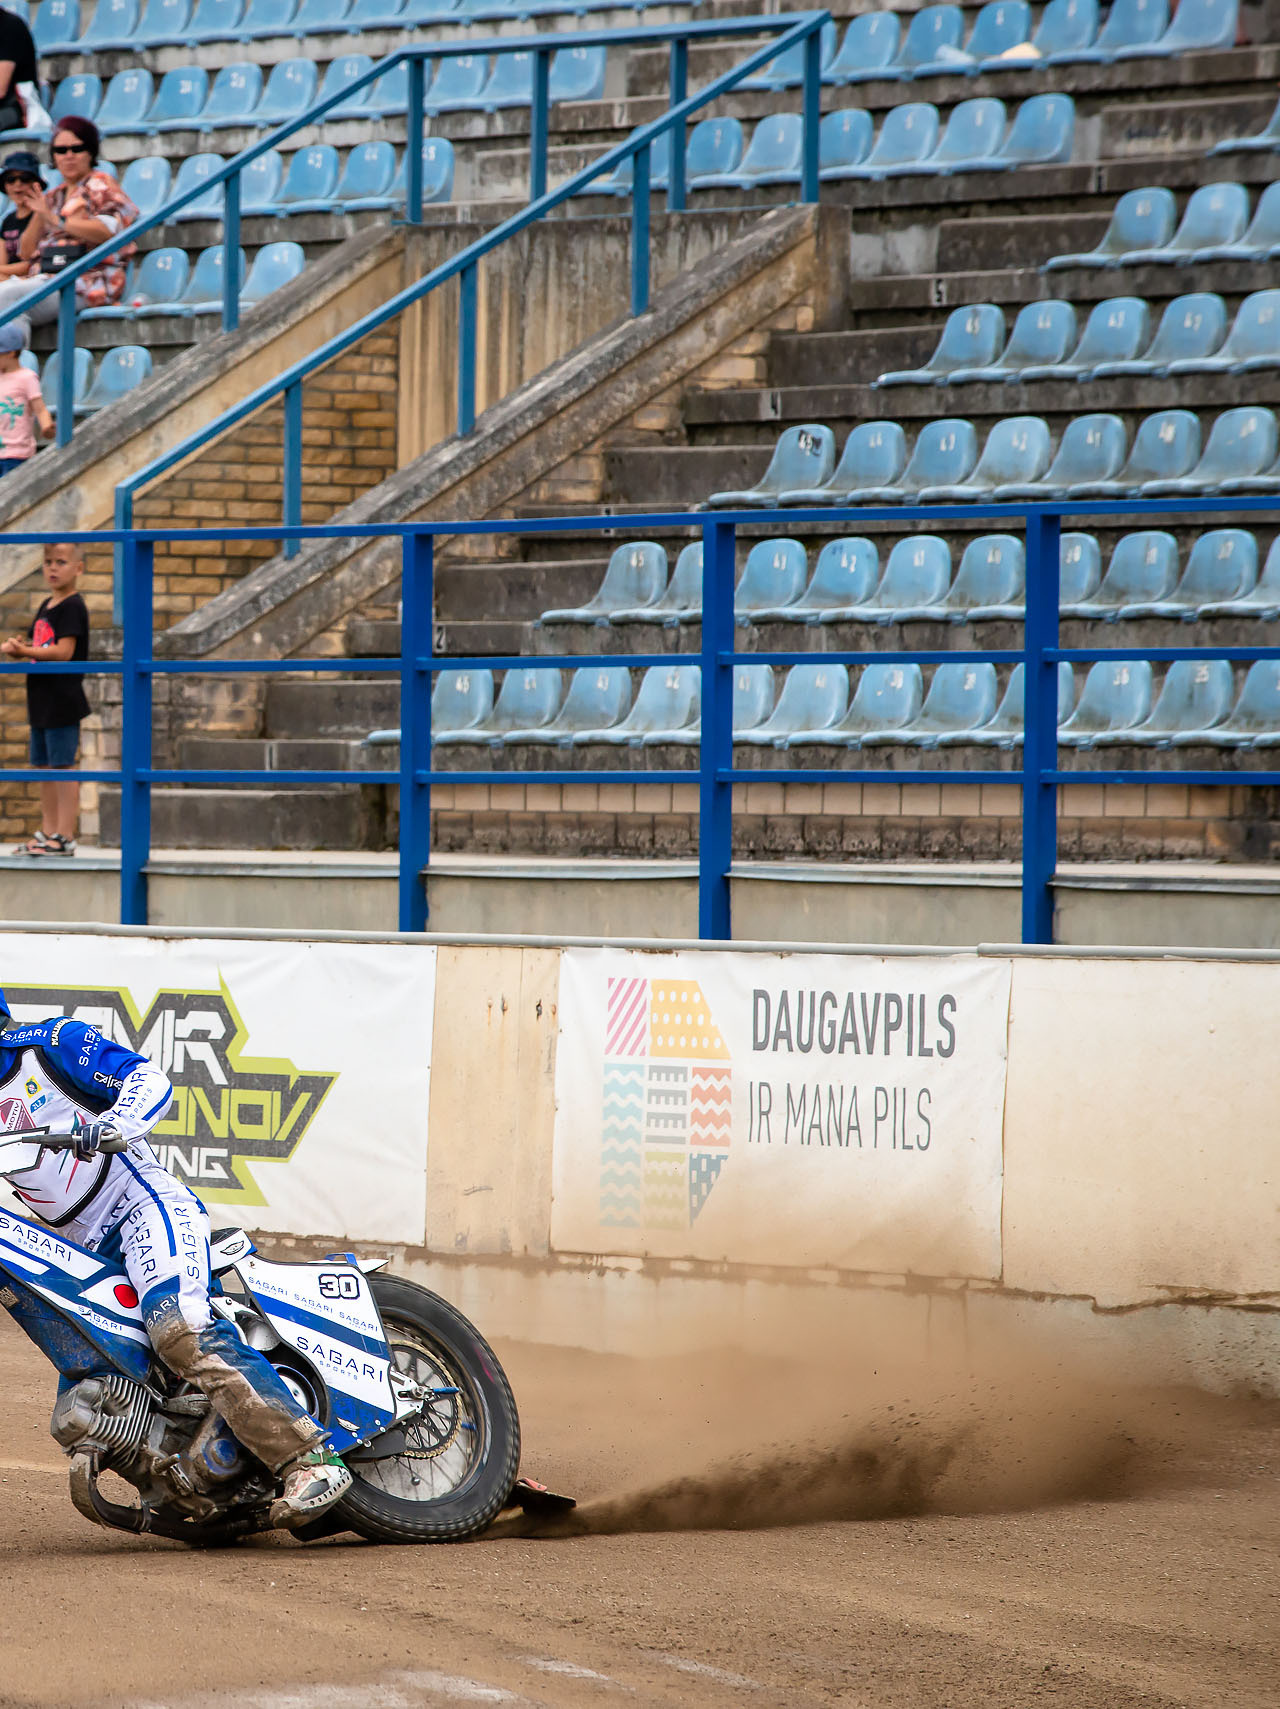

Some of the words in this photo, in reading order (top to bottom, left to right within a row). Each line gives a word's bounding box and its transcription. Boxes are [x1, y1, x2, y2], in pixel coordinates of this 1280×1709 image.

[3, 1028, 48, 1042] SAGARI
[752, 989, 957, 1058] DAUGAVPILS
[748, 1081, 772, 1143] IR
[785, 1083, 862, 1148] MANA
[874, 1086, 932, 1151] PILS
[18, 1238, 51, 1257] SPORTS
[318, 1273, 360, 1300] 30
[248, 1276, 288, 1296] SAGARI
[294, 1293, 333, 1313] SAGARI
[339, 1312, 378, 1332] SAGARI
[78, 1305, 123, 1331] SAGARI
[296, 1337, 383, 1383] SAGARI
[319, 1361, 358, 1381] SPORTS
